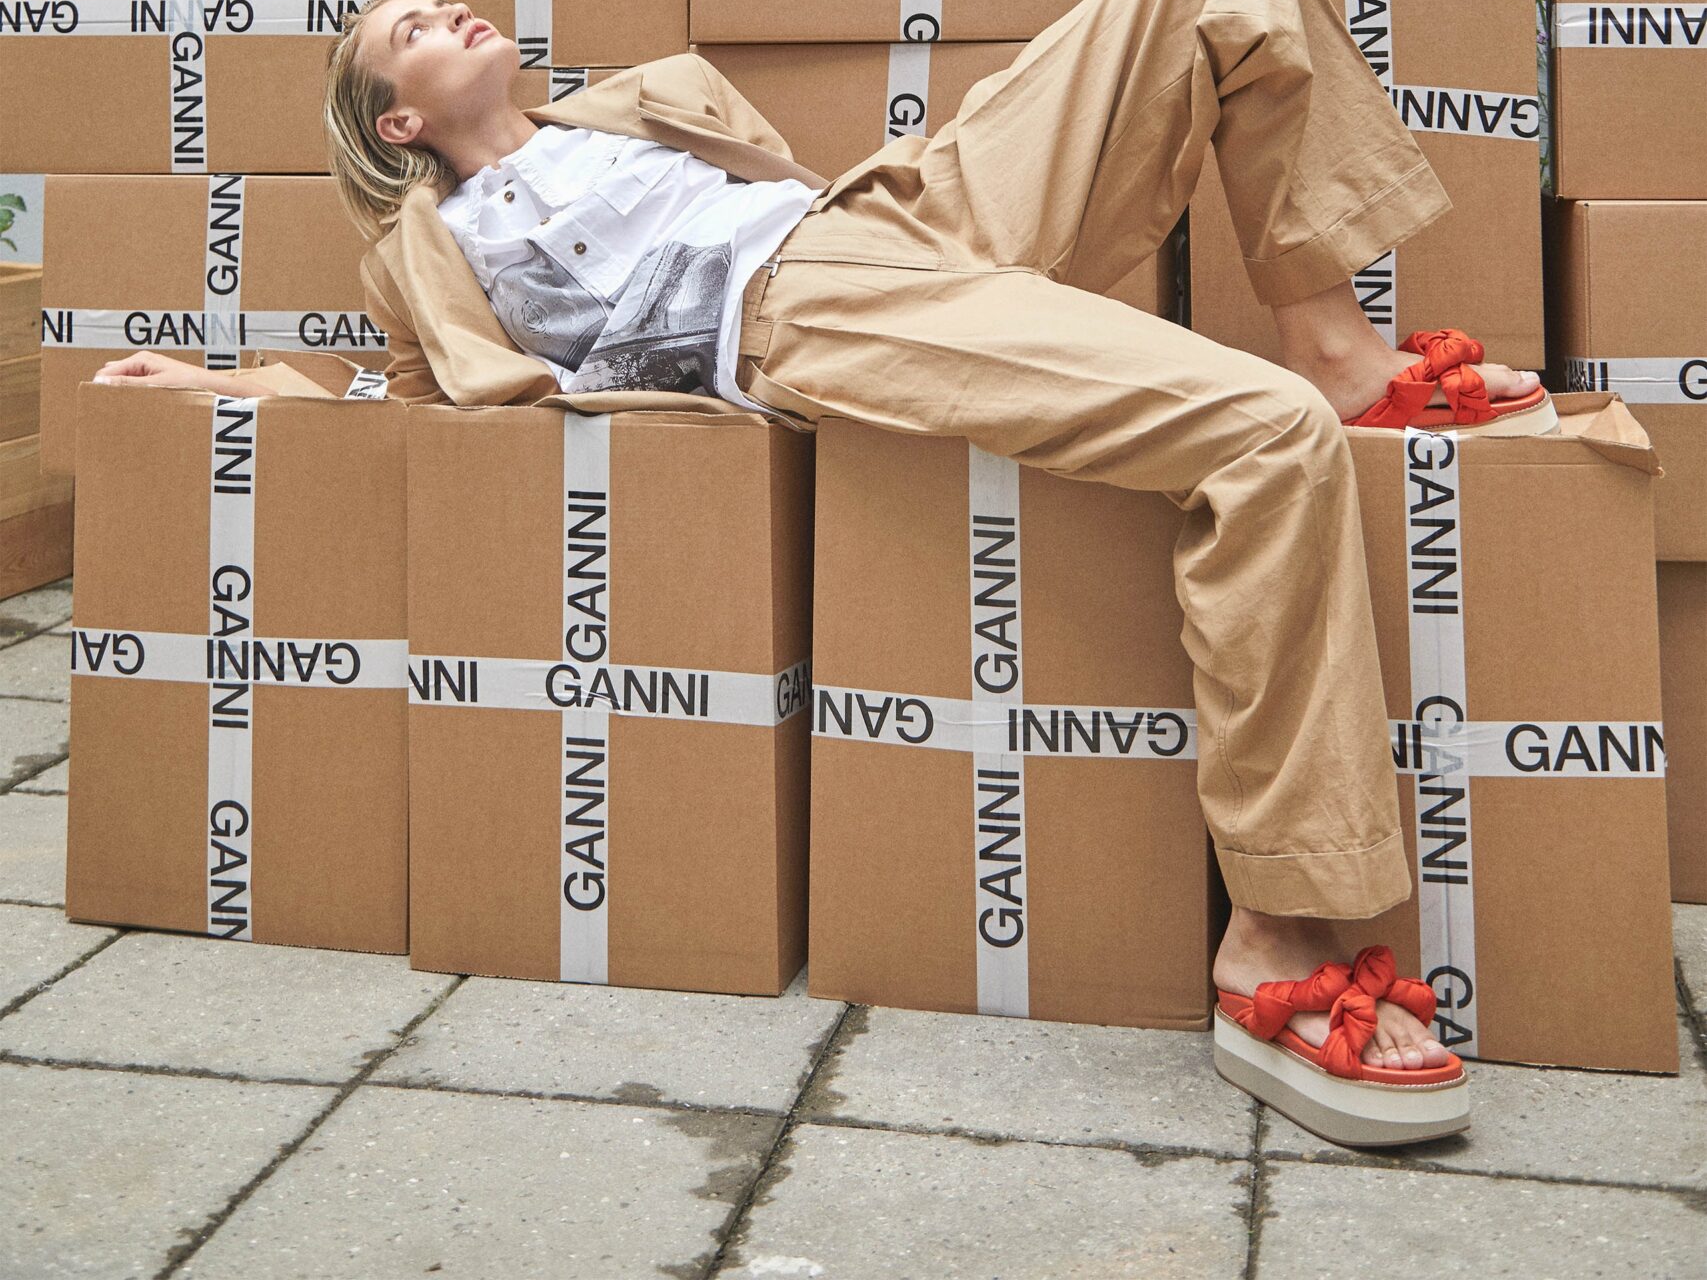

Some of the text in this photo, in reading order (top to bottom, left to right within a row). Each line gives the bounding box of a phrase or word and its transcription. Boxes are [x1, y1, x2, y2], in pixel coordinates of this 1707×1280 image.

[172, 31, 205, 164] GANNI
[214, 398, 254, 495] NNI
[1407, 433, 1459, 614] GANNI
[212, 564, 251, 729] GANI
[565, 490, 607, 663] GANNI
[973, 515, 1019, 694] GANNI
[206, 639, 361, 685] GANNI
[545, 664, 709, 718] GANNI
[812, 689, 1189, 757] GAN GANNI
[563, 736, 606, 911] GANNI
[978, 768, 1024, 949] GANNI
